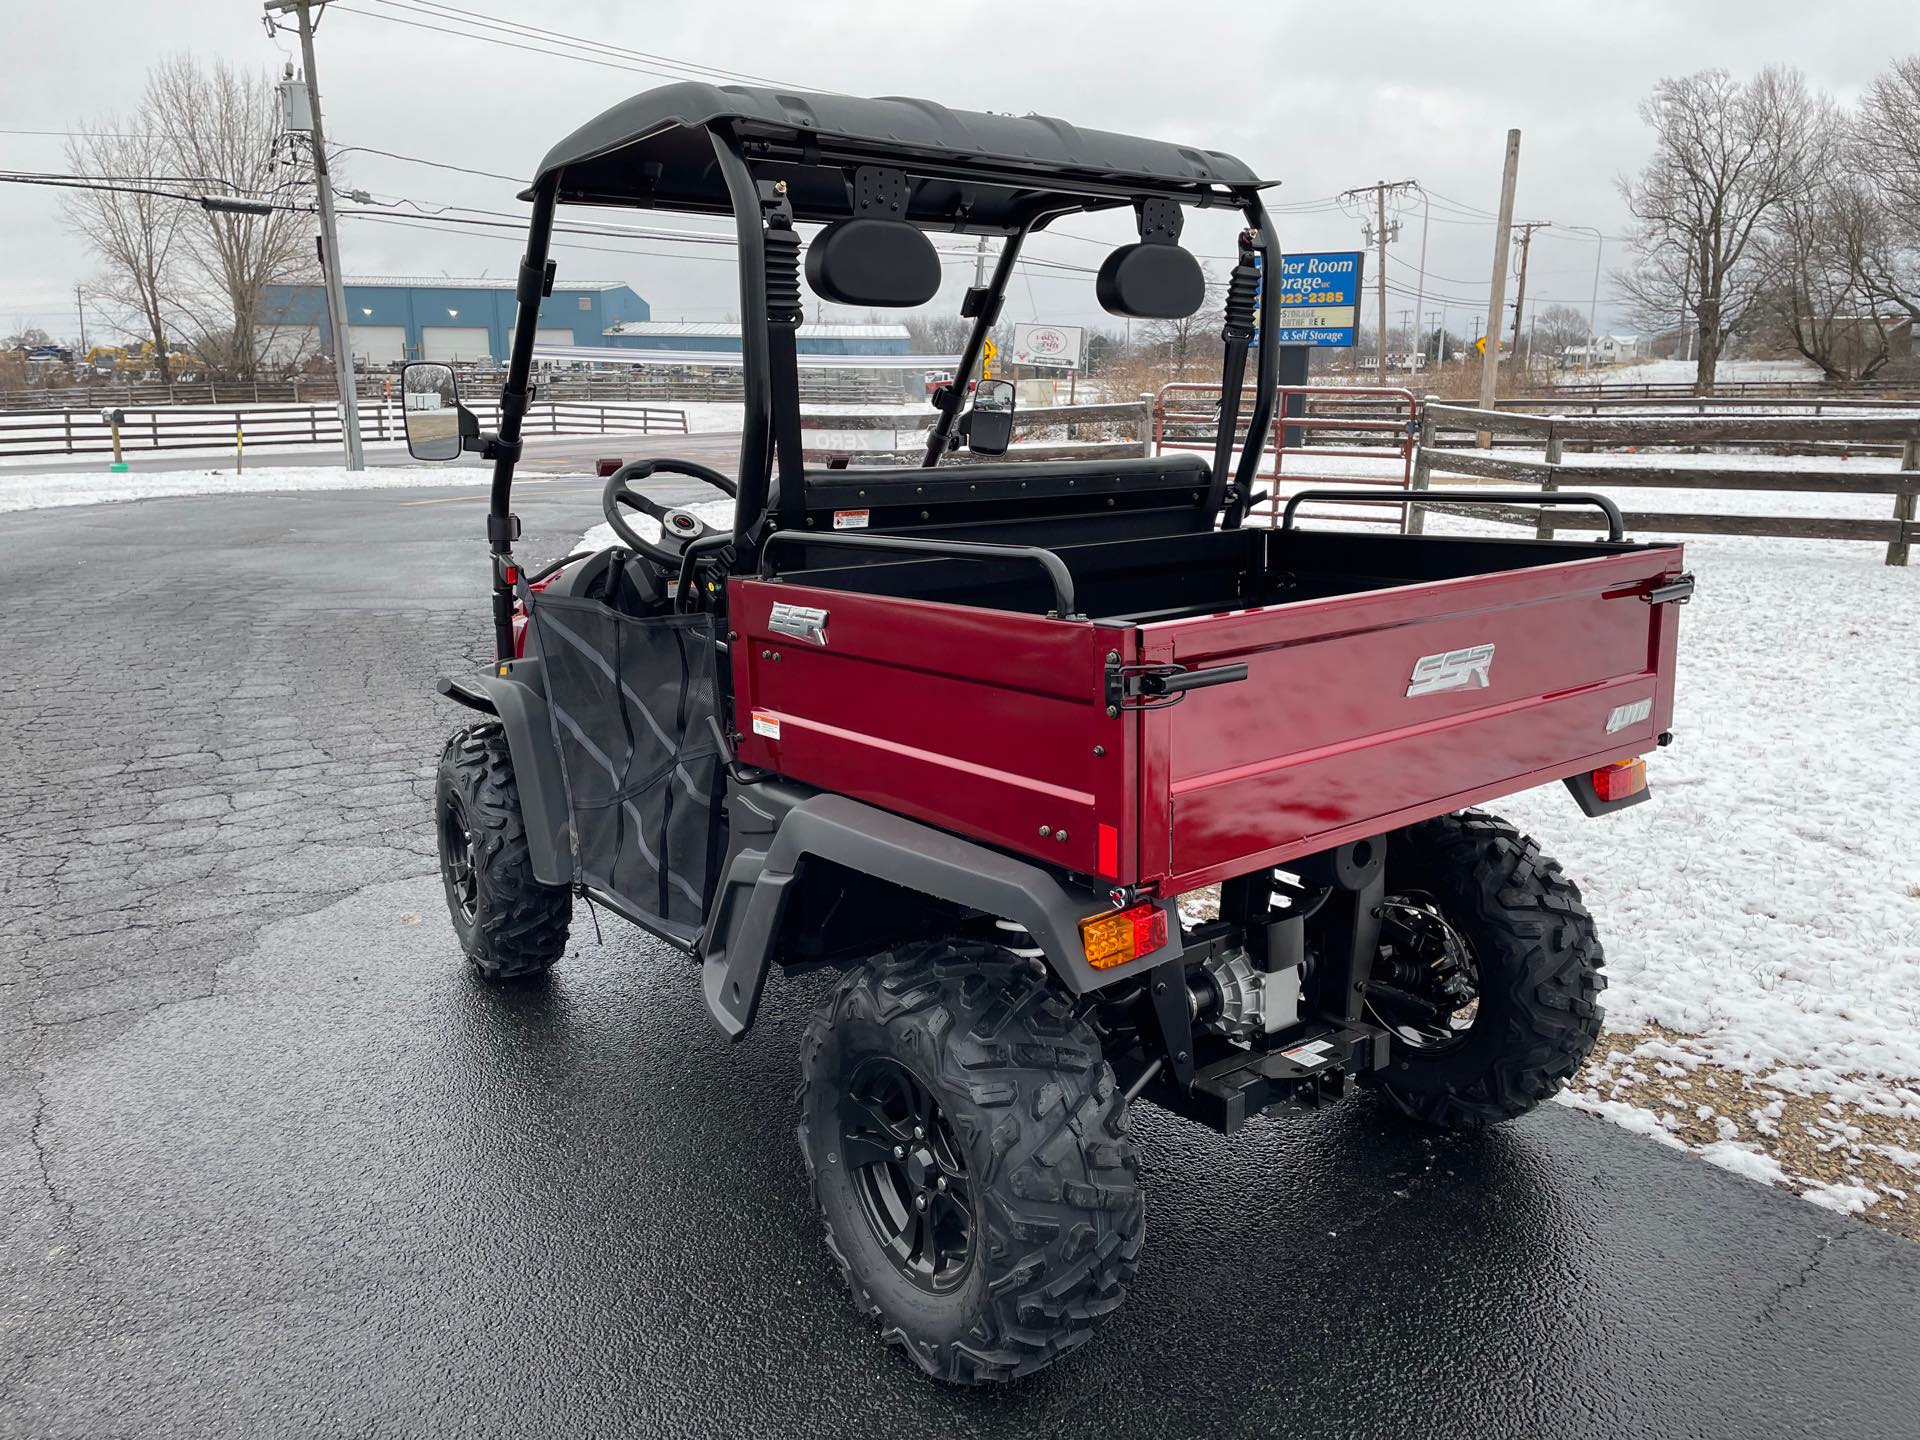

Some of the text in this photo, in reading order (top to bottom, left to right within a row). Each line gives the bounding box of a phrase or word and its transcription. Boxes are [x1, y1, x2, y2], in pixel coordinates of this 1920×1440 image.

[1281, 258, 1353, 275] her Room
[1281, 277, 1322, 294] orage
[1280, 292, 1344, 304] 923-2385
[1282, 331, 1290, 341] &
[1291, 330, 1308, 341] Self
[1309, 329, 1344, 343] Storage
[768, 601, 828, 647] SSR
[1406, 643, 1495, 698] SSR
